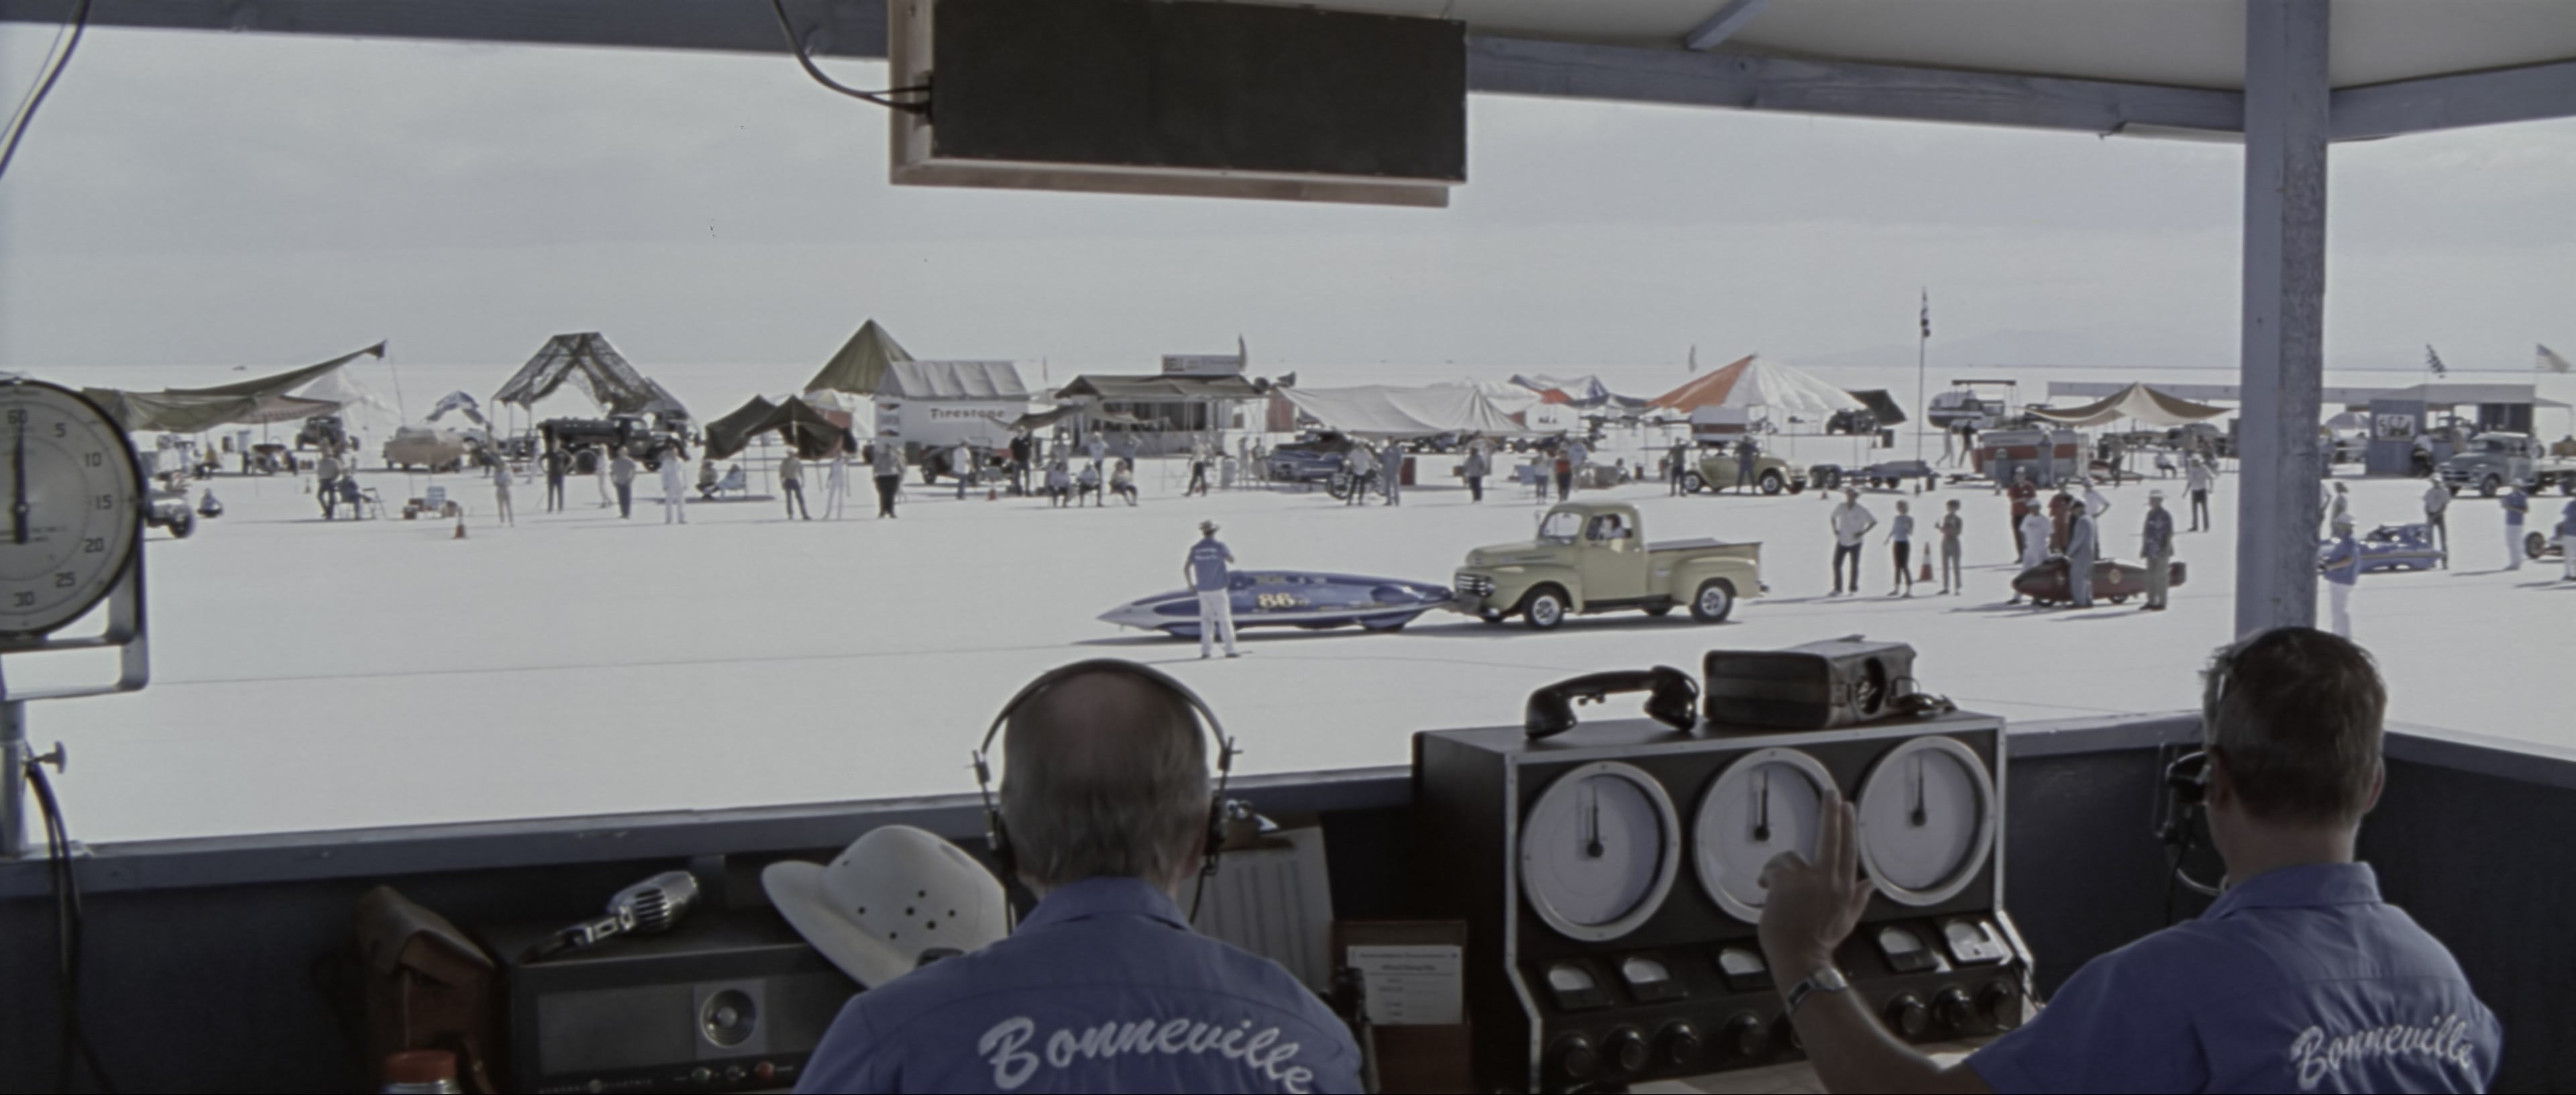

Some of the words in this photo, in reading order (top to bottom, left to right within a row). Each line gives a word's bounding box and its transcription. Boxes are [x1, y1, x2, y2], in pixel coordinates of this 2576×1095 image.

[8, 409, 28, 424] 60
[930, 408, 1005, 420] Firestone
[55, 423, 66, 437] 5
[85, 452, 101, 466] 10
[95, 494, 113, 510] 15
[84, 538, 104, 553] 20
[55, 572, 75, 588] 25
[13, 591, 35, 607] 30
[1257, 592, 1295, 607] 86
[979, 1016, 1313, 1094] Bonneville
[2290, 1014, 2474, 1090] Bonneville
